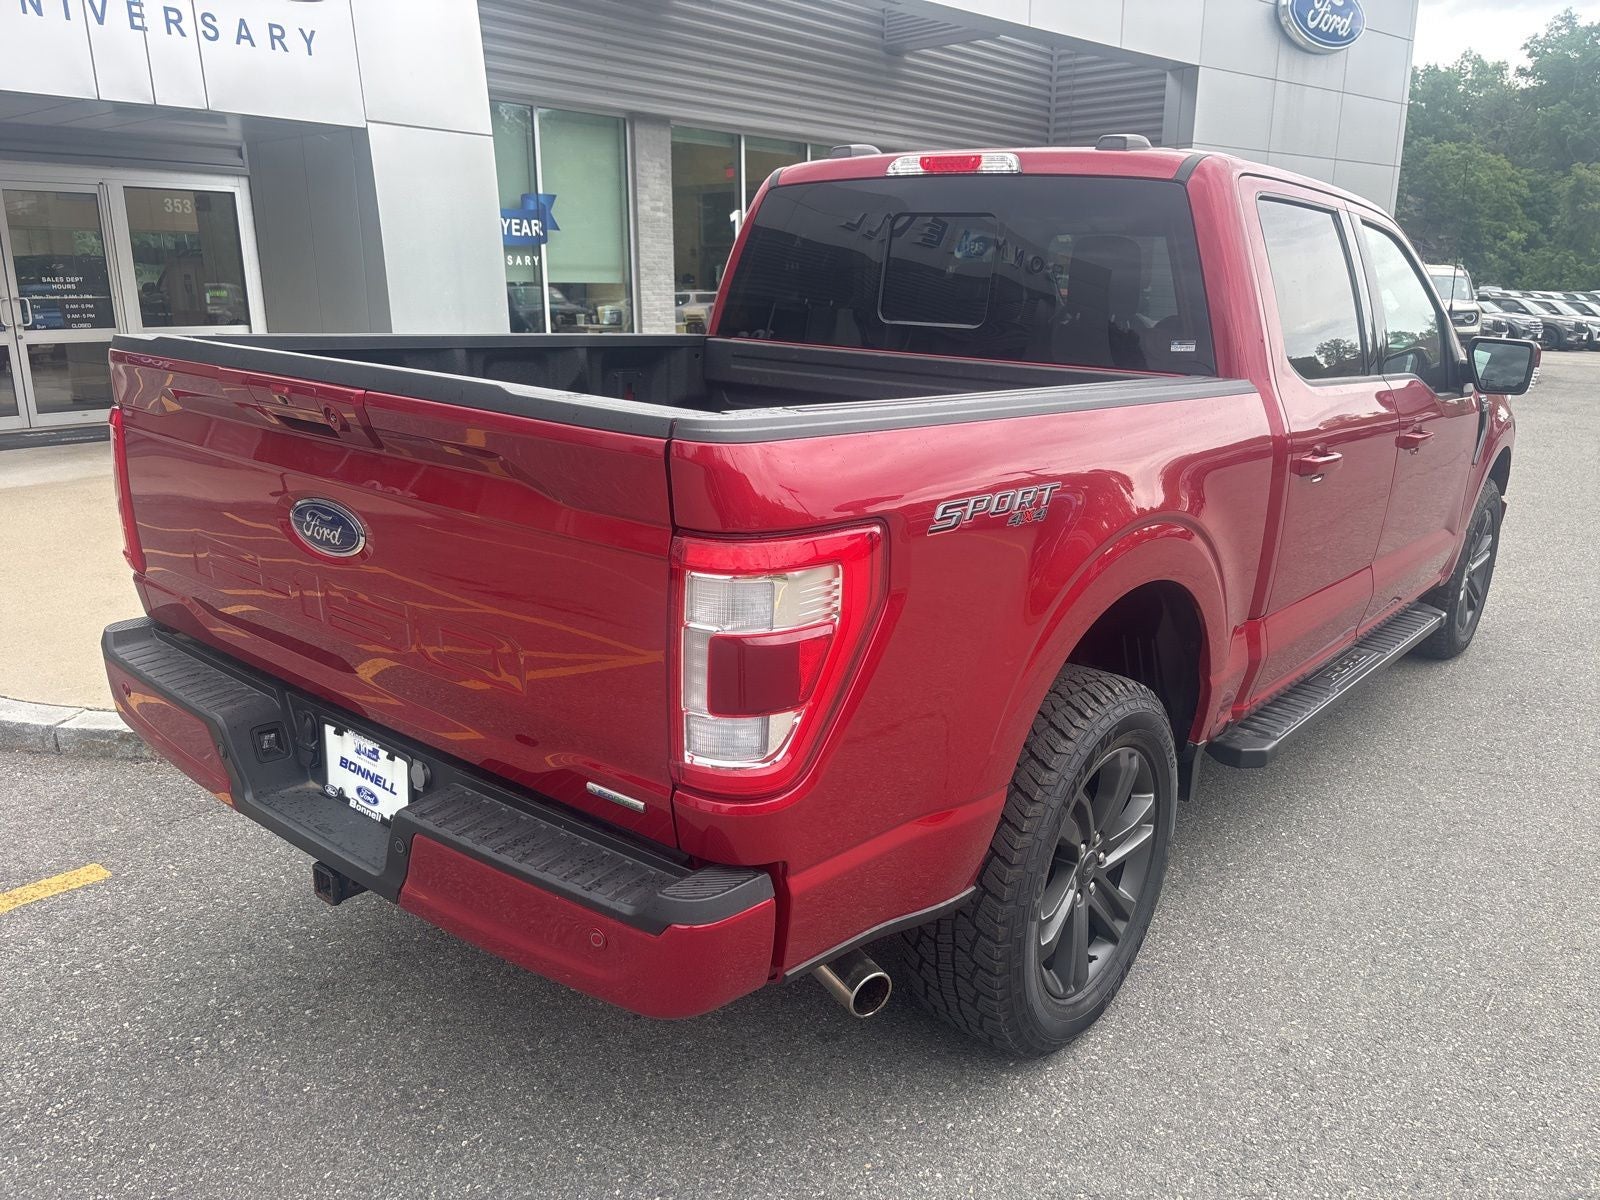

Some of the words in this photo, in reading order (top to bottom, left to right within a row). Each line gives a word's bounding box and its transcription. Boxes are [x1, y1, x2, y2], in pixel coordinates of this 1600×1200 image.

[1307, 0, 1354, 37] Ford
[163, 198, 193, 214] 353
[501, 217, 544, 236] YEAR
[507, 254, 539, 266] SARY
[927, 482, 1062, 536] SPORT
[303, 508, 343, 546] Ford
[339, 755, 397, 796] BONNELL
[349, 797, 382, 822] Bonnell
